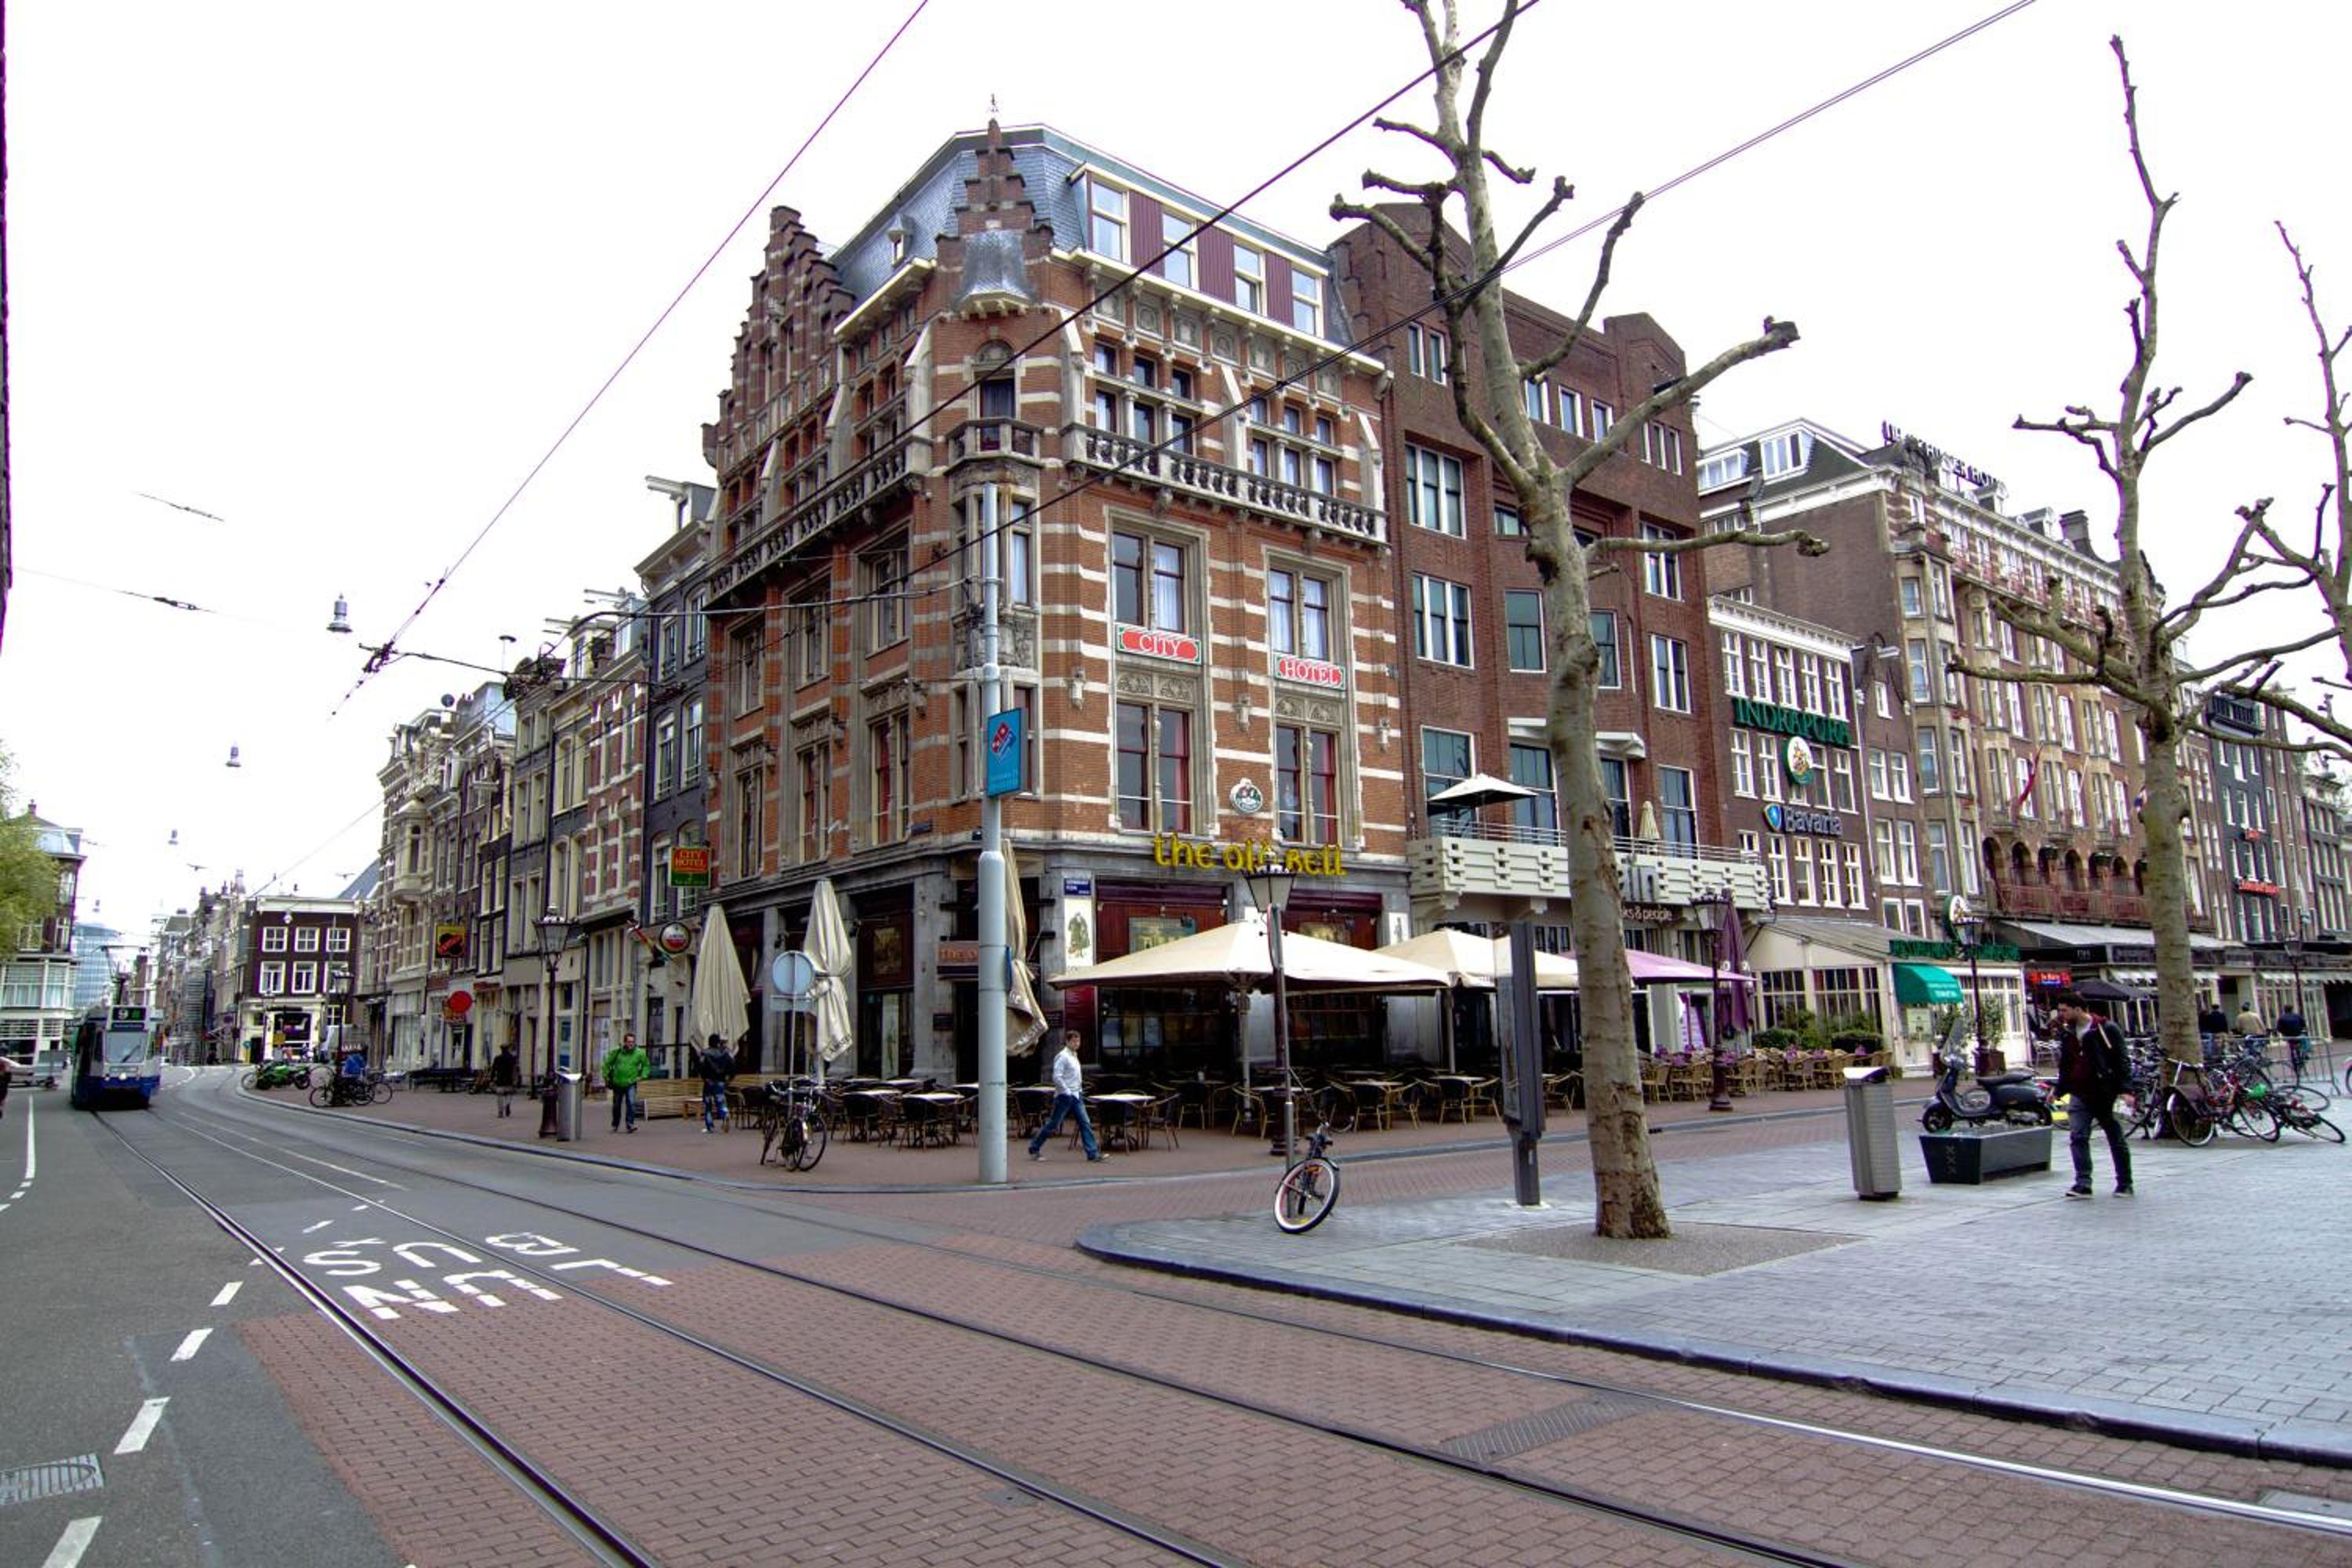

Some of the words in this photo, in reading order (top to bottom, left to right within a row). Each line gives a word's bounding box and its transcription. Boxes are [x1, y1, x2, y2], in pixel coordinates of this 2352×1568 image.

[1138, 633, 1181, 655] CITY
[1283, 659, 1338, 684] HOTEL
[1733, 697, 1852, 746] INDRAPURA
[1783, 805, 1843, 835] Bavaria
[1153, 831, 1214, 869] the
[1643, 904, 1673, 924] people
